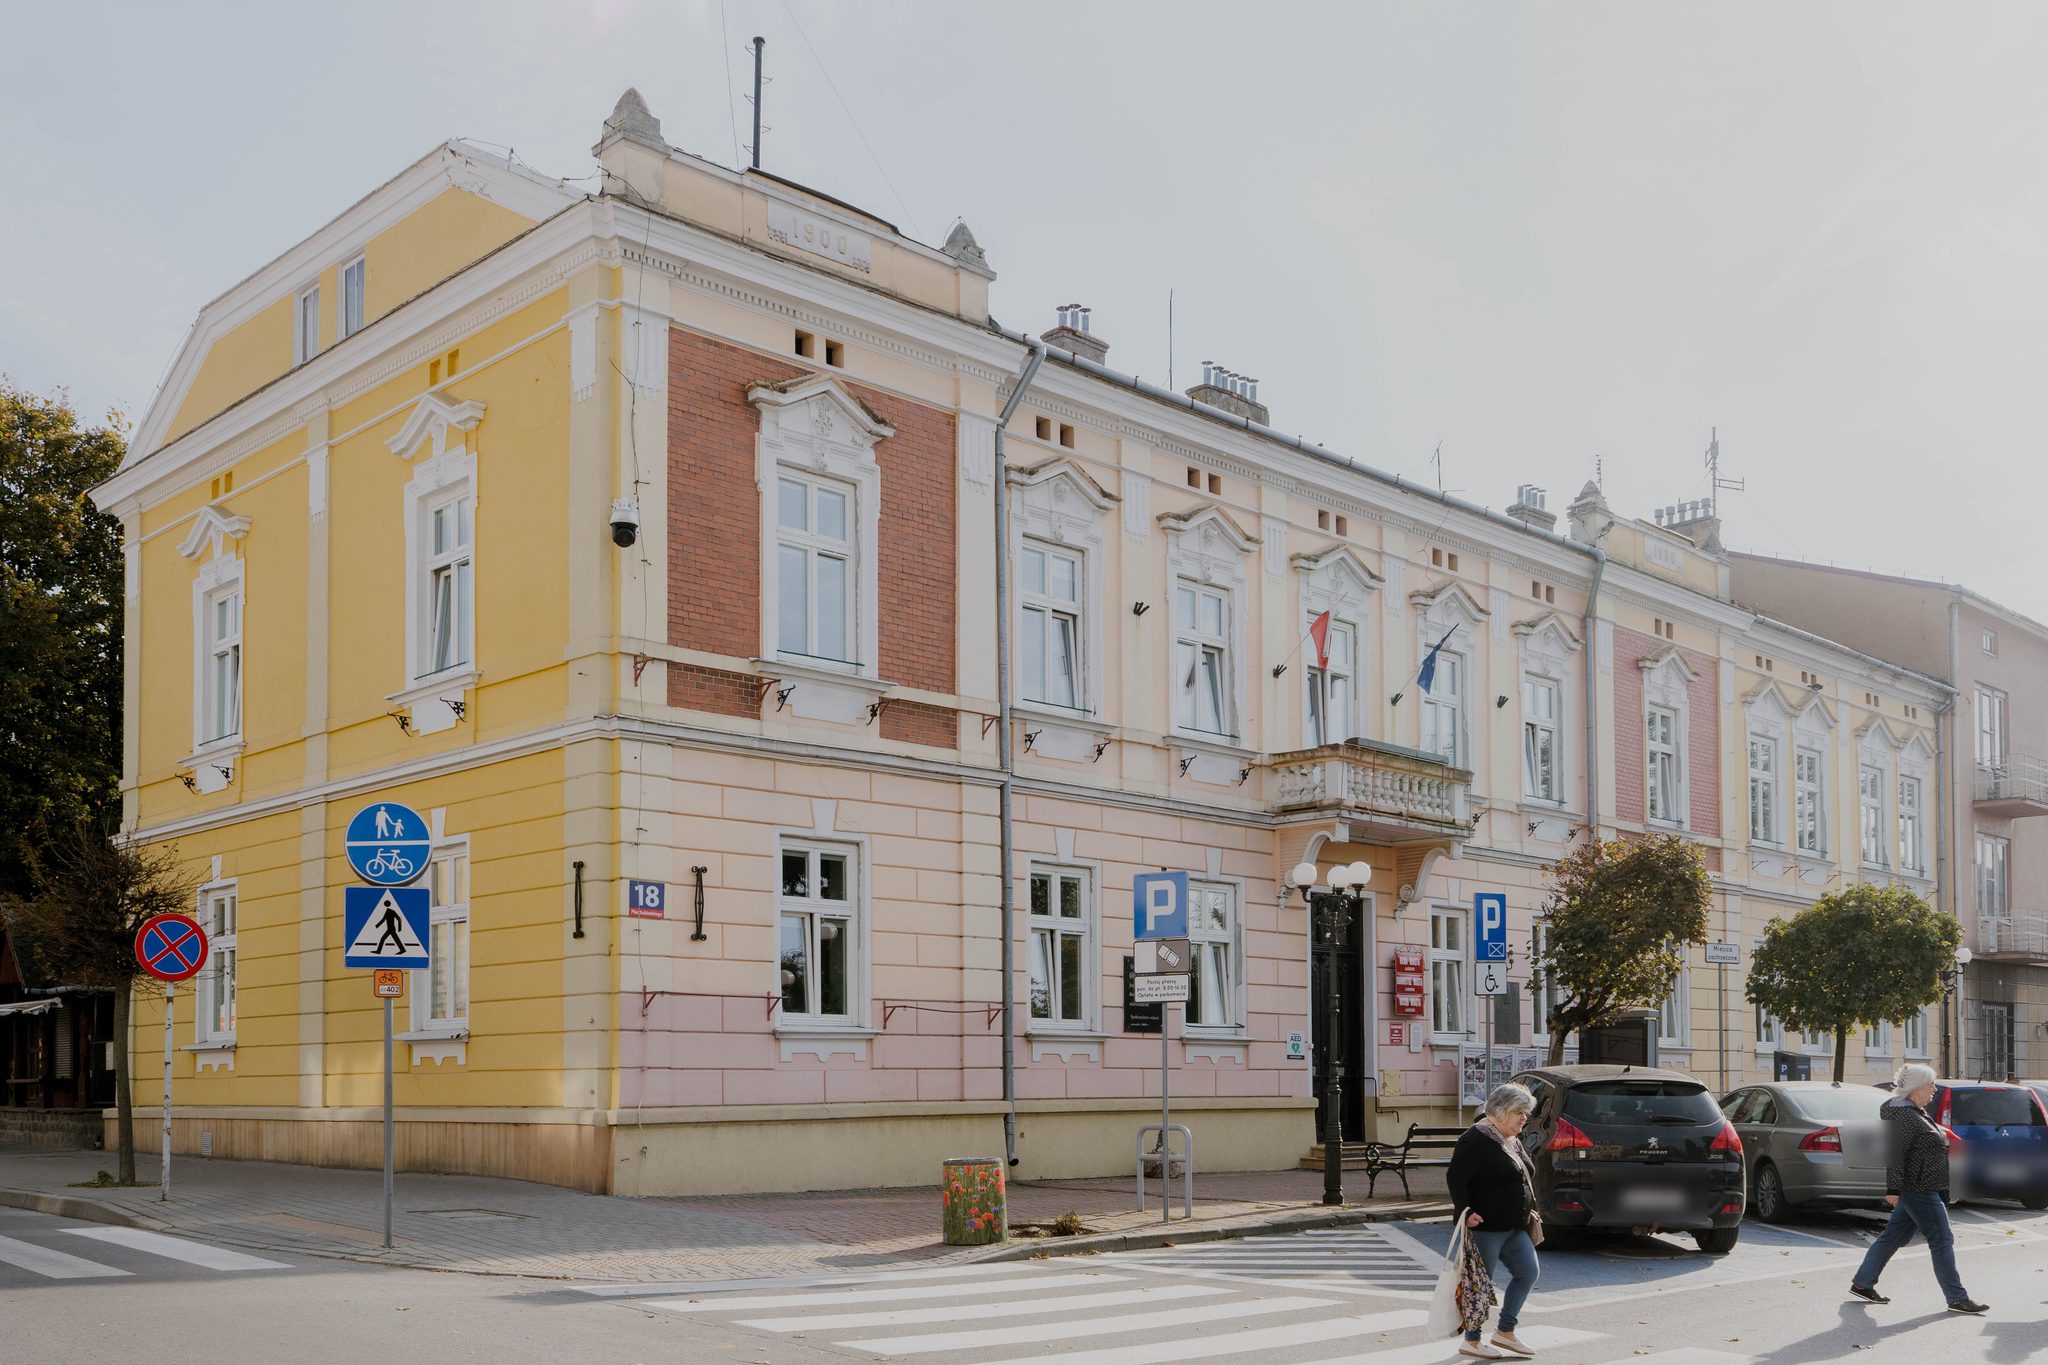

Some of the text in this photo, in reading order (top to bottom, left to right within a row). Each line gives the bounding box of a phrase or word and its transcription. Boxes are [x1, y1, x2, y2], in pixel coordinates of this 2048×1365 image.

[635, 884, 659, 907] 18
[1146, 880, 1176, 931] P
[1482, 899, 1500, 941] P
[1781, 1064, 1788, 1073] P
